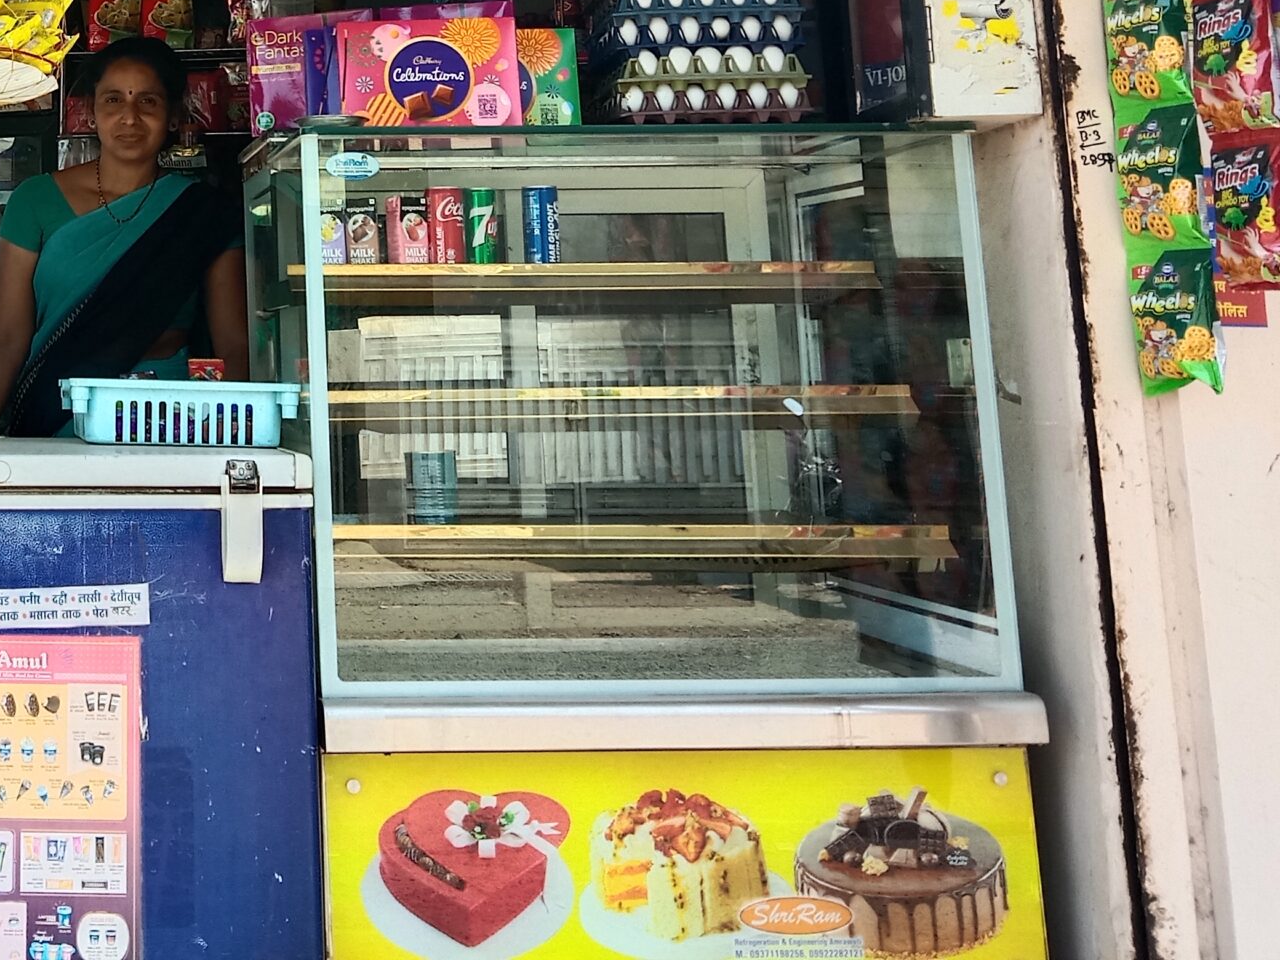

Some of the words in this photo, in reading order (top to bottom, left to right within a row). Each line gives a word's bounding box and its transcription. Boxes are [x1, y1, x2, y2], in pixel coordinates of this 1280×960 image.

[1107, 6, 1162, 33] Wheelos
[264, 30, 303, 45] Dark
[255, 44, 305, 60] Fantas
[393, 66, 465, 82] Celebrations
[1076, 110, 1100, 125] BMC
[1118, 144, 1177, 173] Wheelos
[350, 248, 375, 257] MILK
[405, 247, 428, 257] MILK
[1131, 292, 1196, 313] Wheelos
[20, 591, 40, 605] पनीर
[52, 590, 67, 606] दही
[0, 610, 19, 622] ताक
[29, 609, 58, 620] मसाला
[62, 608, 81, 620] ताक
[751, 903, 842, 926] ShriRam
